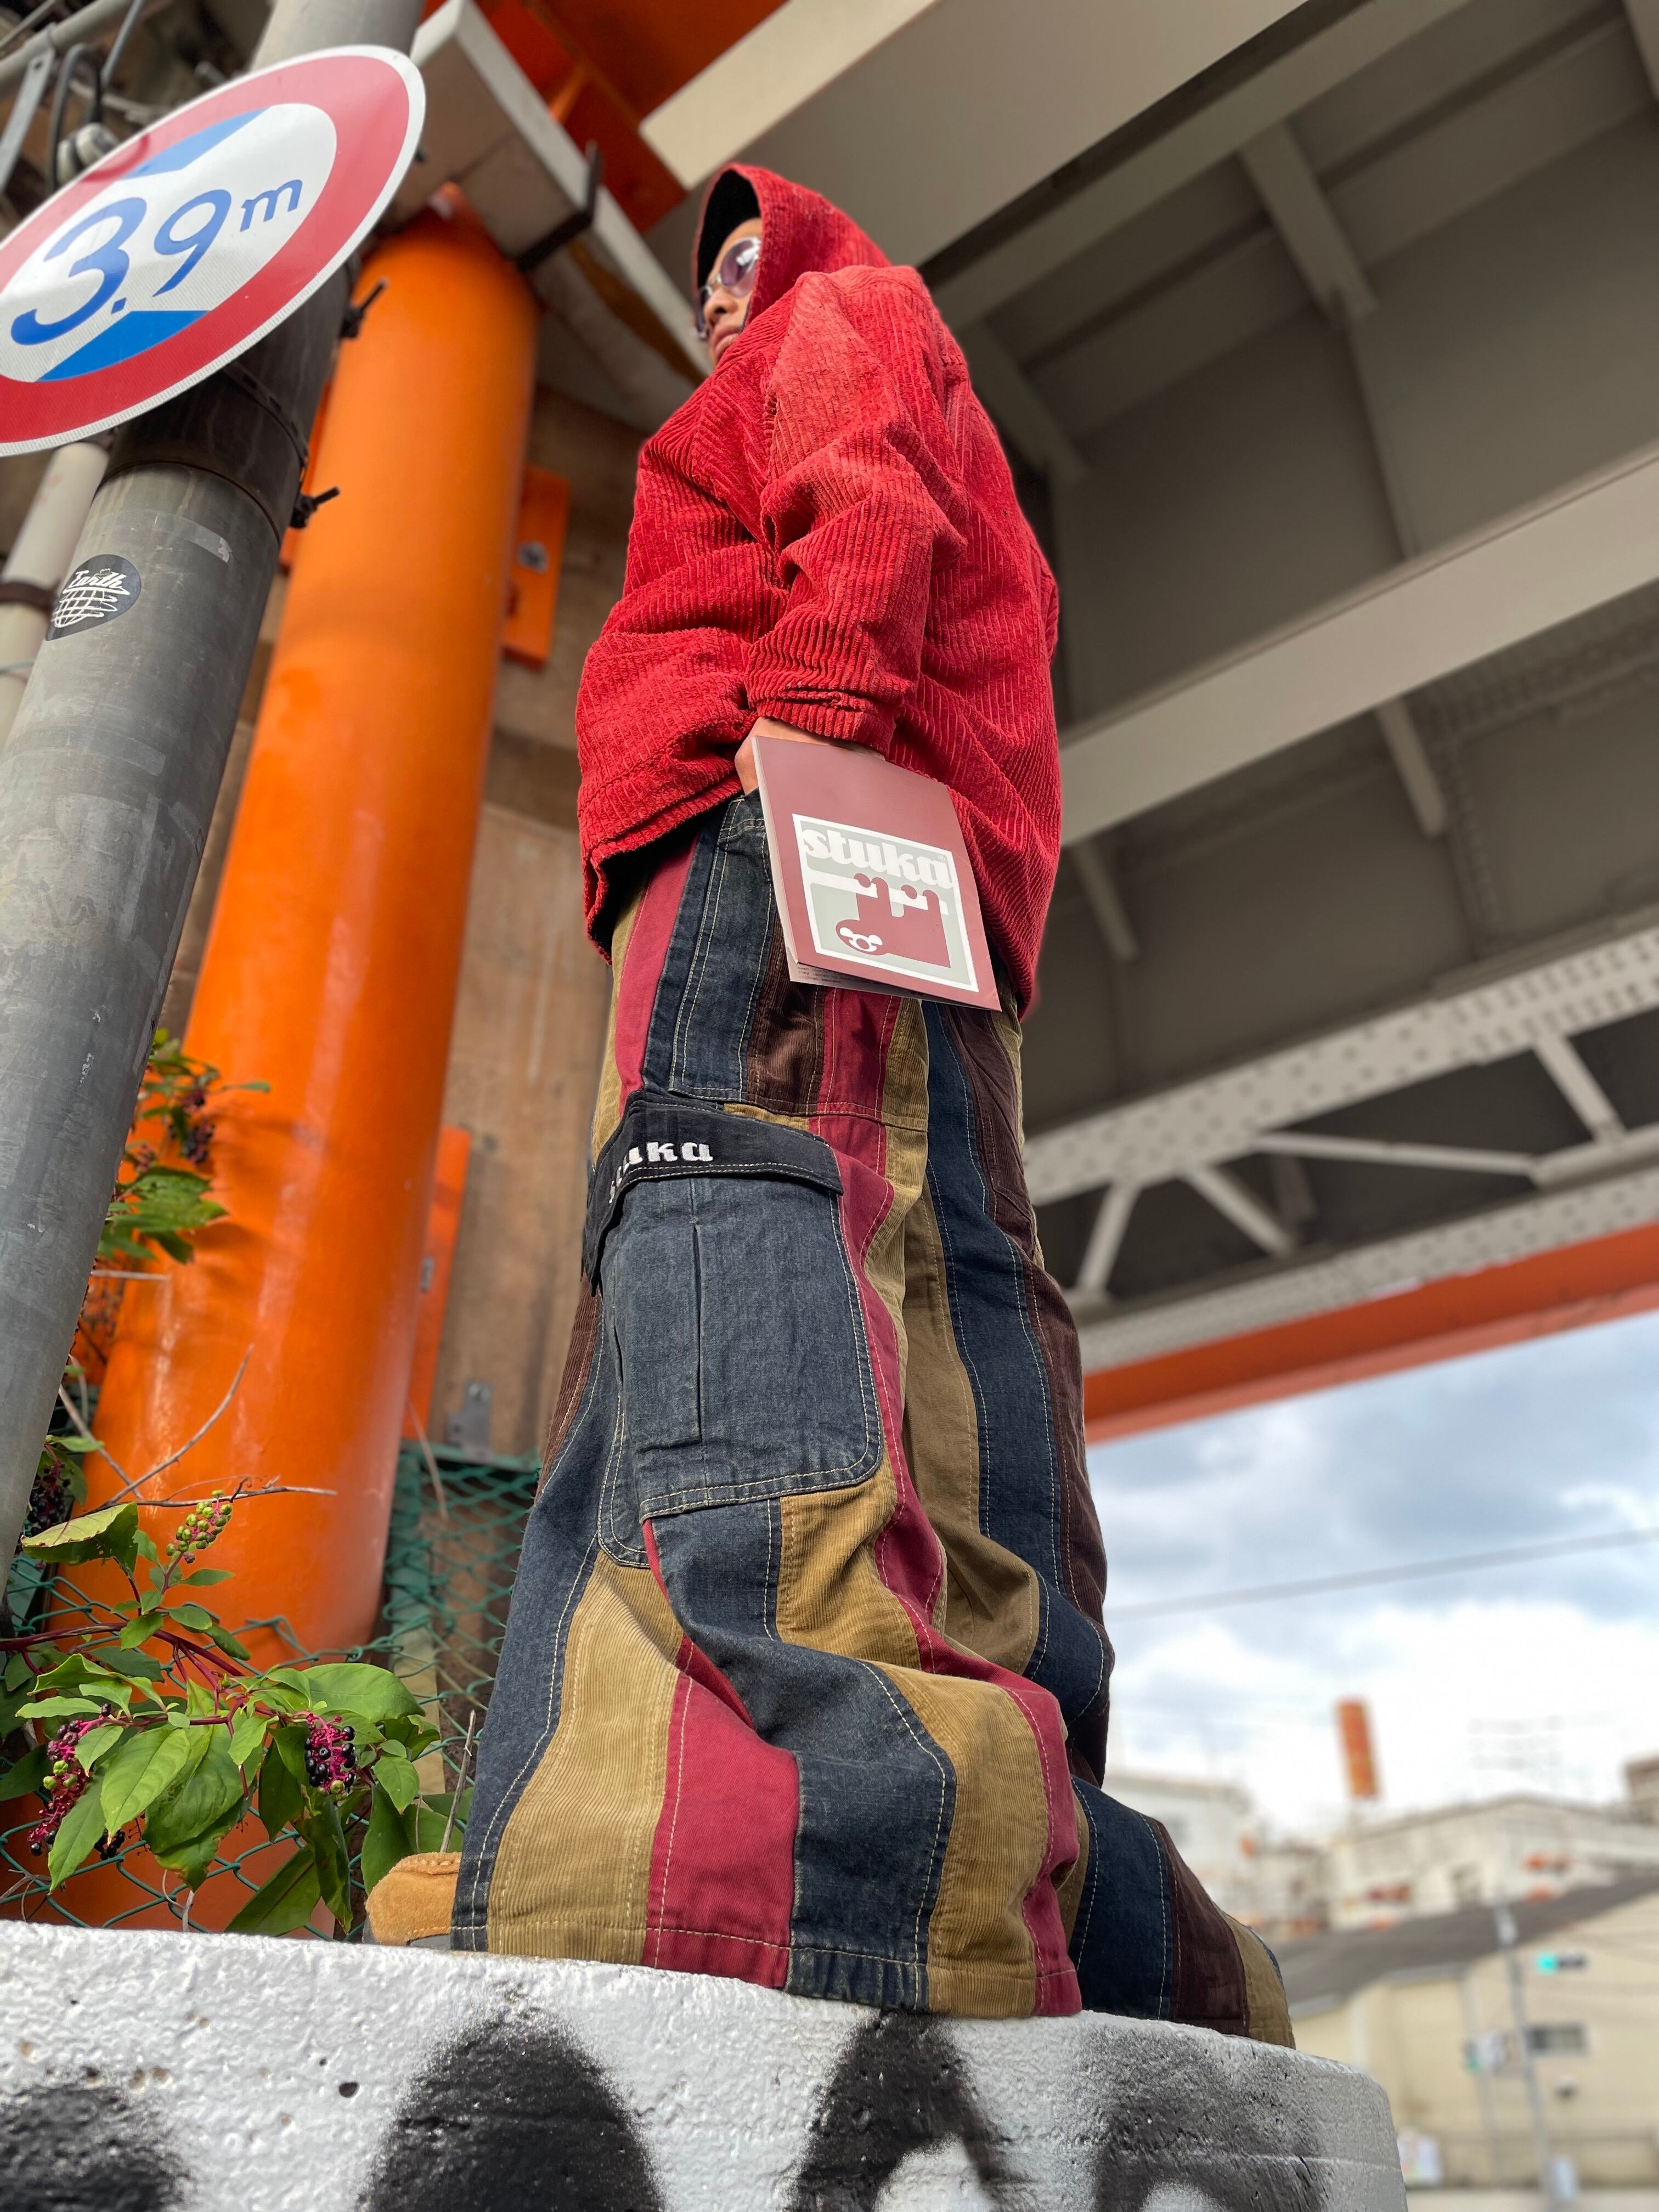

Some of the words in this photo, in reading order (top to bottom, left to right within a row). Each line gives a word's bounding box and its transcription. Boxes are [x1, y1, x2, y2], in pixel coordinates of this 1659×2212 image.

[11, 179, 302, 345] 3.9m
[67, 569, 128, 591] Earth
[801, 829, 953, 889] stuka
